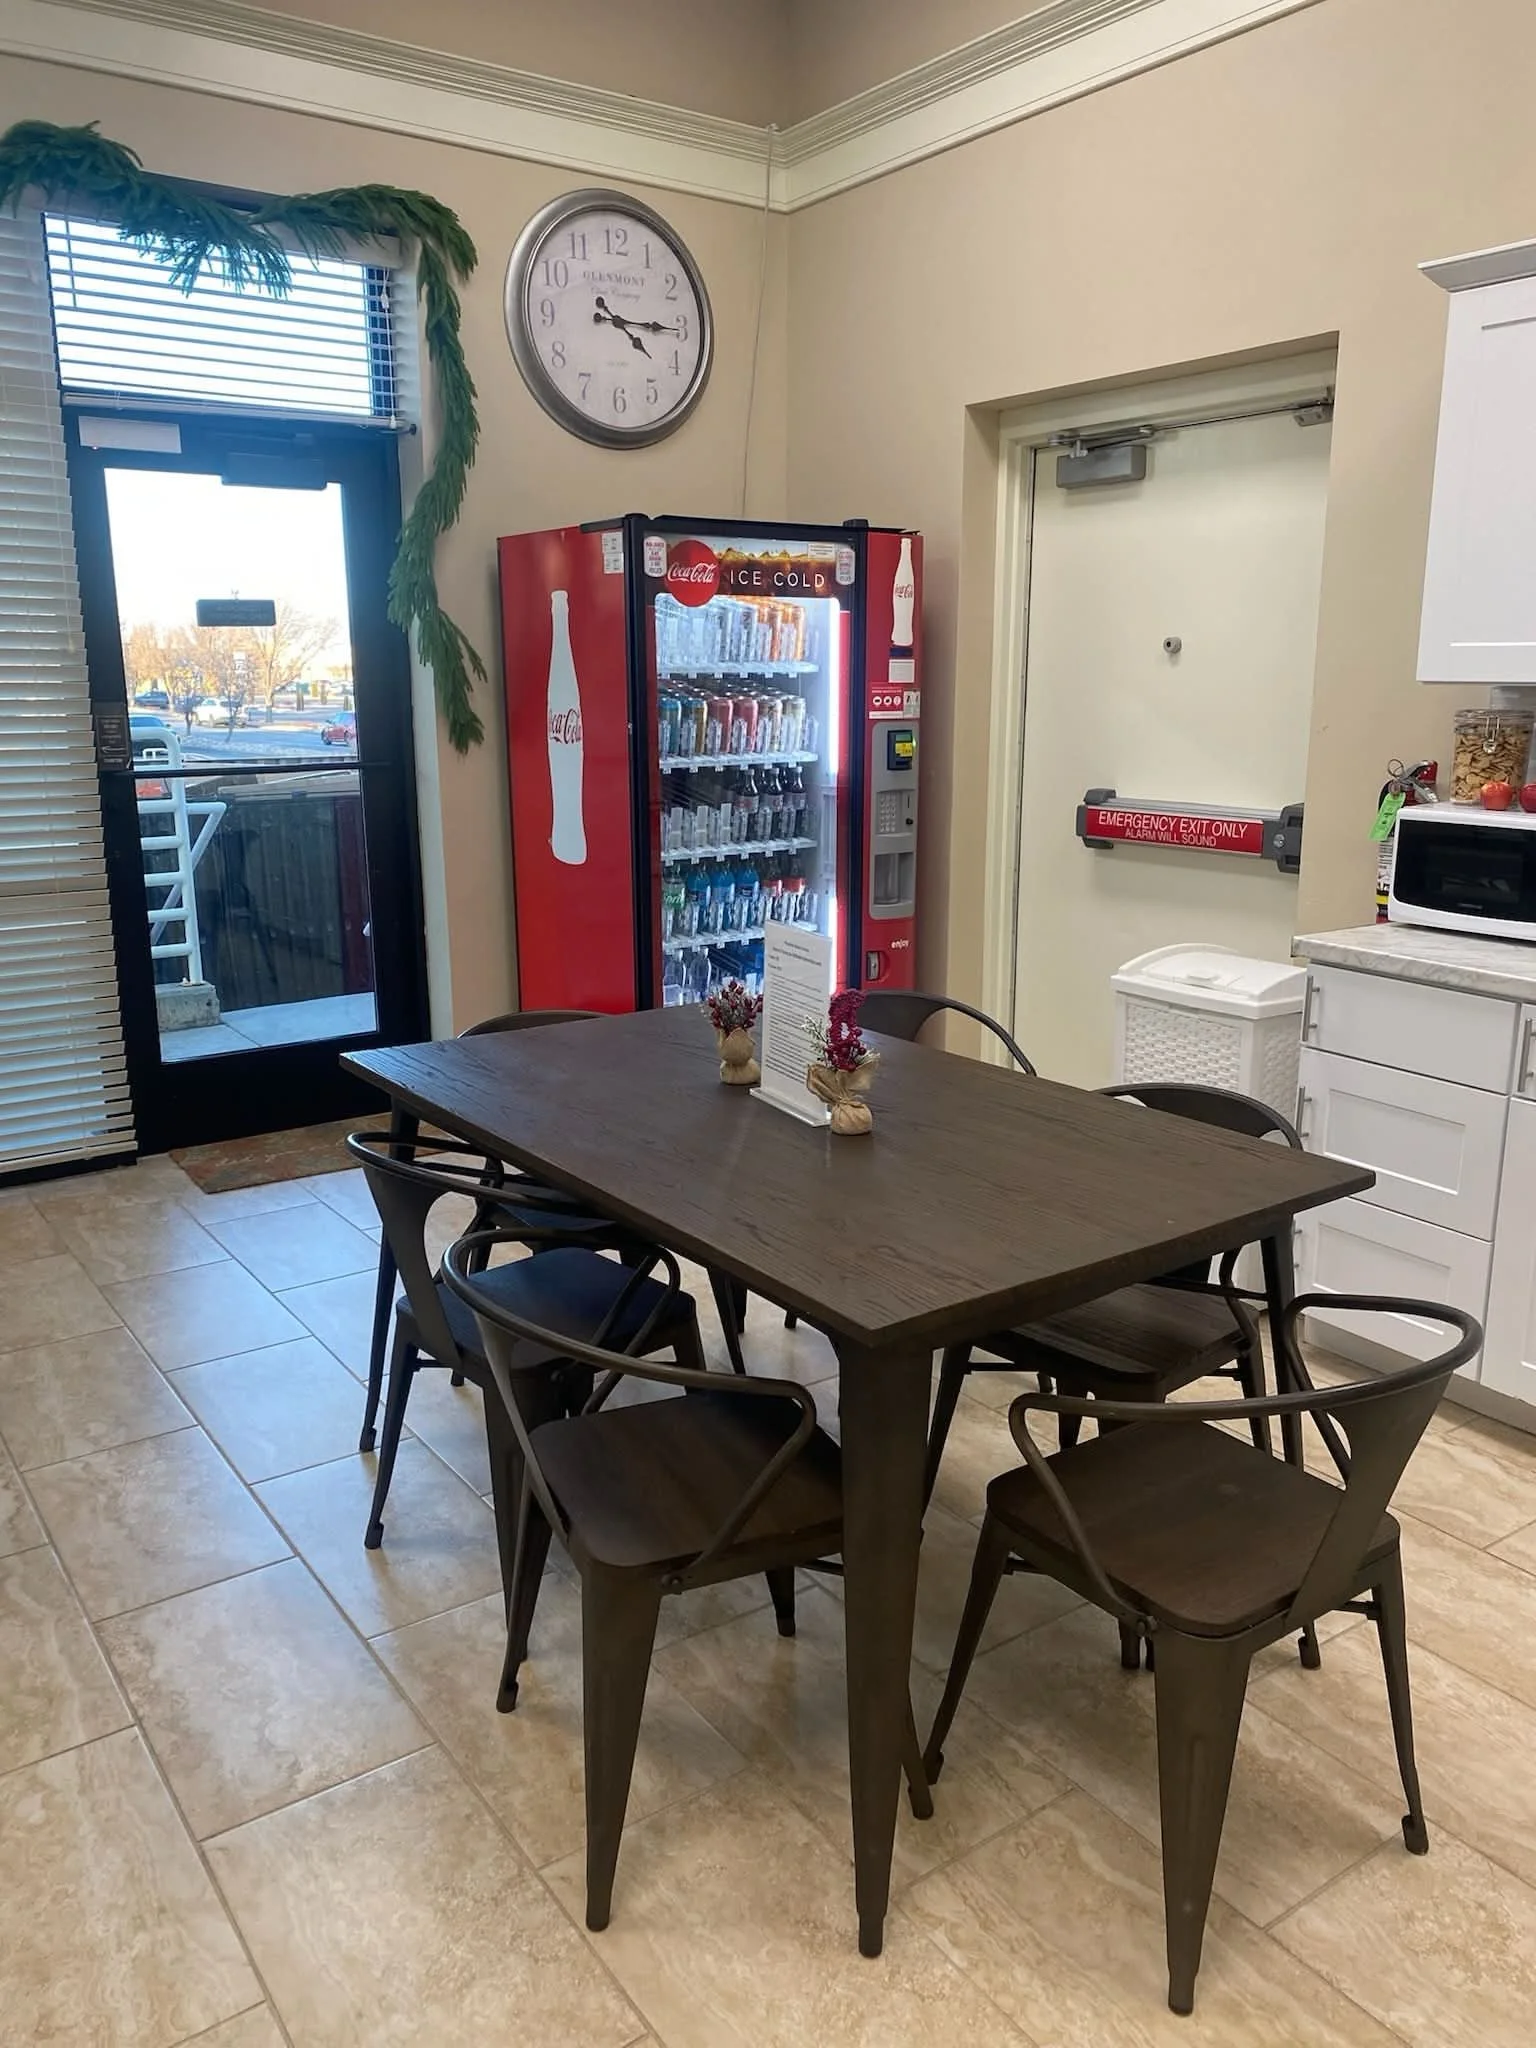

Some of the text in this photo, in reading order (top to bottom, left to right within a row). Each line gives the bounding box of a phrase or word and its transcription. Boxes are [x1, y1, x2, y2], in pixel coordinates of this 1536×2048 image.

[567, 232, 590, 261] 11
[604, 228, 629, 257] 12
[641, 242, 652, 269] 1
[541, 259, 569, 289] 10
[664, 273, 678, 301] 2
[540, 299, 555, 328] 9
[675, 314, 688, 343] 3
[551, 341, 566, 369] 8
[668, 350, 681, 376] 4
[578, 372, 592, 401] 7
[612, 386, 627, 414] 6
[646, 378, 658, 406] 5
[667, 561, 718, 584] Coca-Cola
[730, 569, 825, 588] ICE COLD
[1098, 811, 1249, 839] EMERGENCY EXIT ONLY
[1125, 828, 1217, 847] ALARM WILL SOUND
